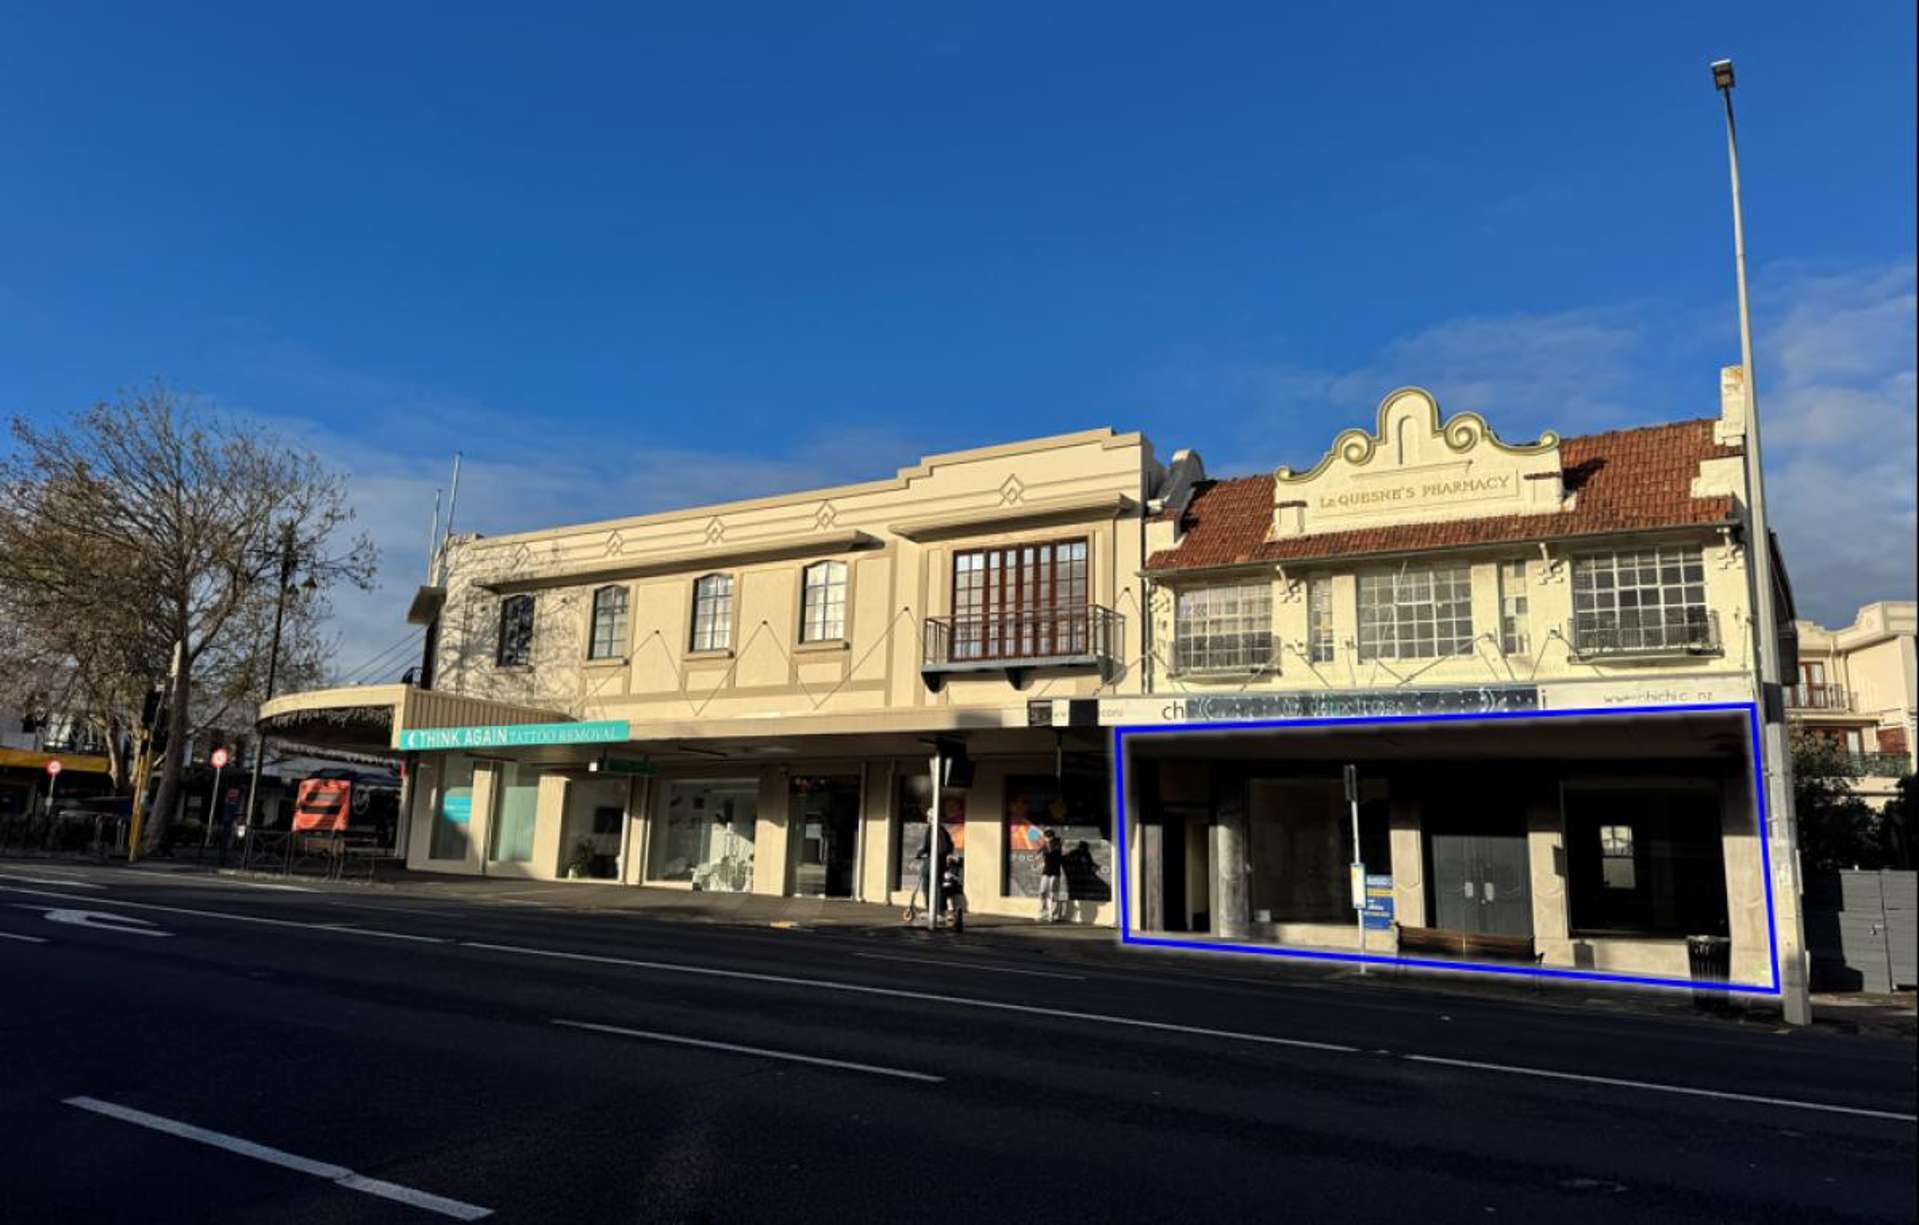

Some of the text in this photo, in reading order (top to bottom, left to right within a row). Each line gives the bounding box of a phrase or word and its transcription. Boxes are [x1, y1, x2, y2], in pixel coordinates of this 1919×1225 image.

[1338, 486, 1416, 505] QUESNE'S
[1422, 476, 1510, 497] PHARMACY
[420, 727, 617, 747] THINK AGAIN TATTOO REMOVAL
